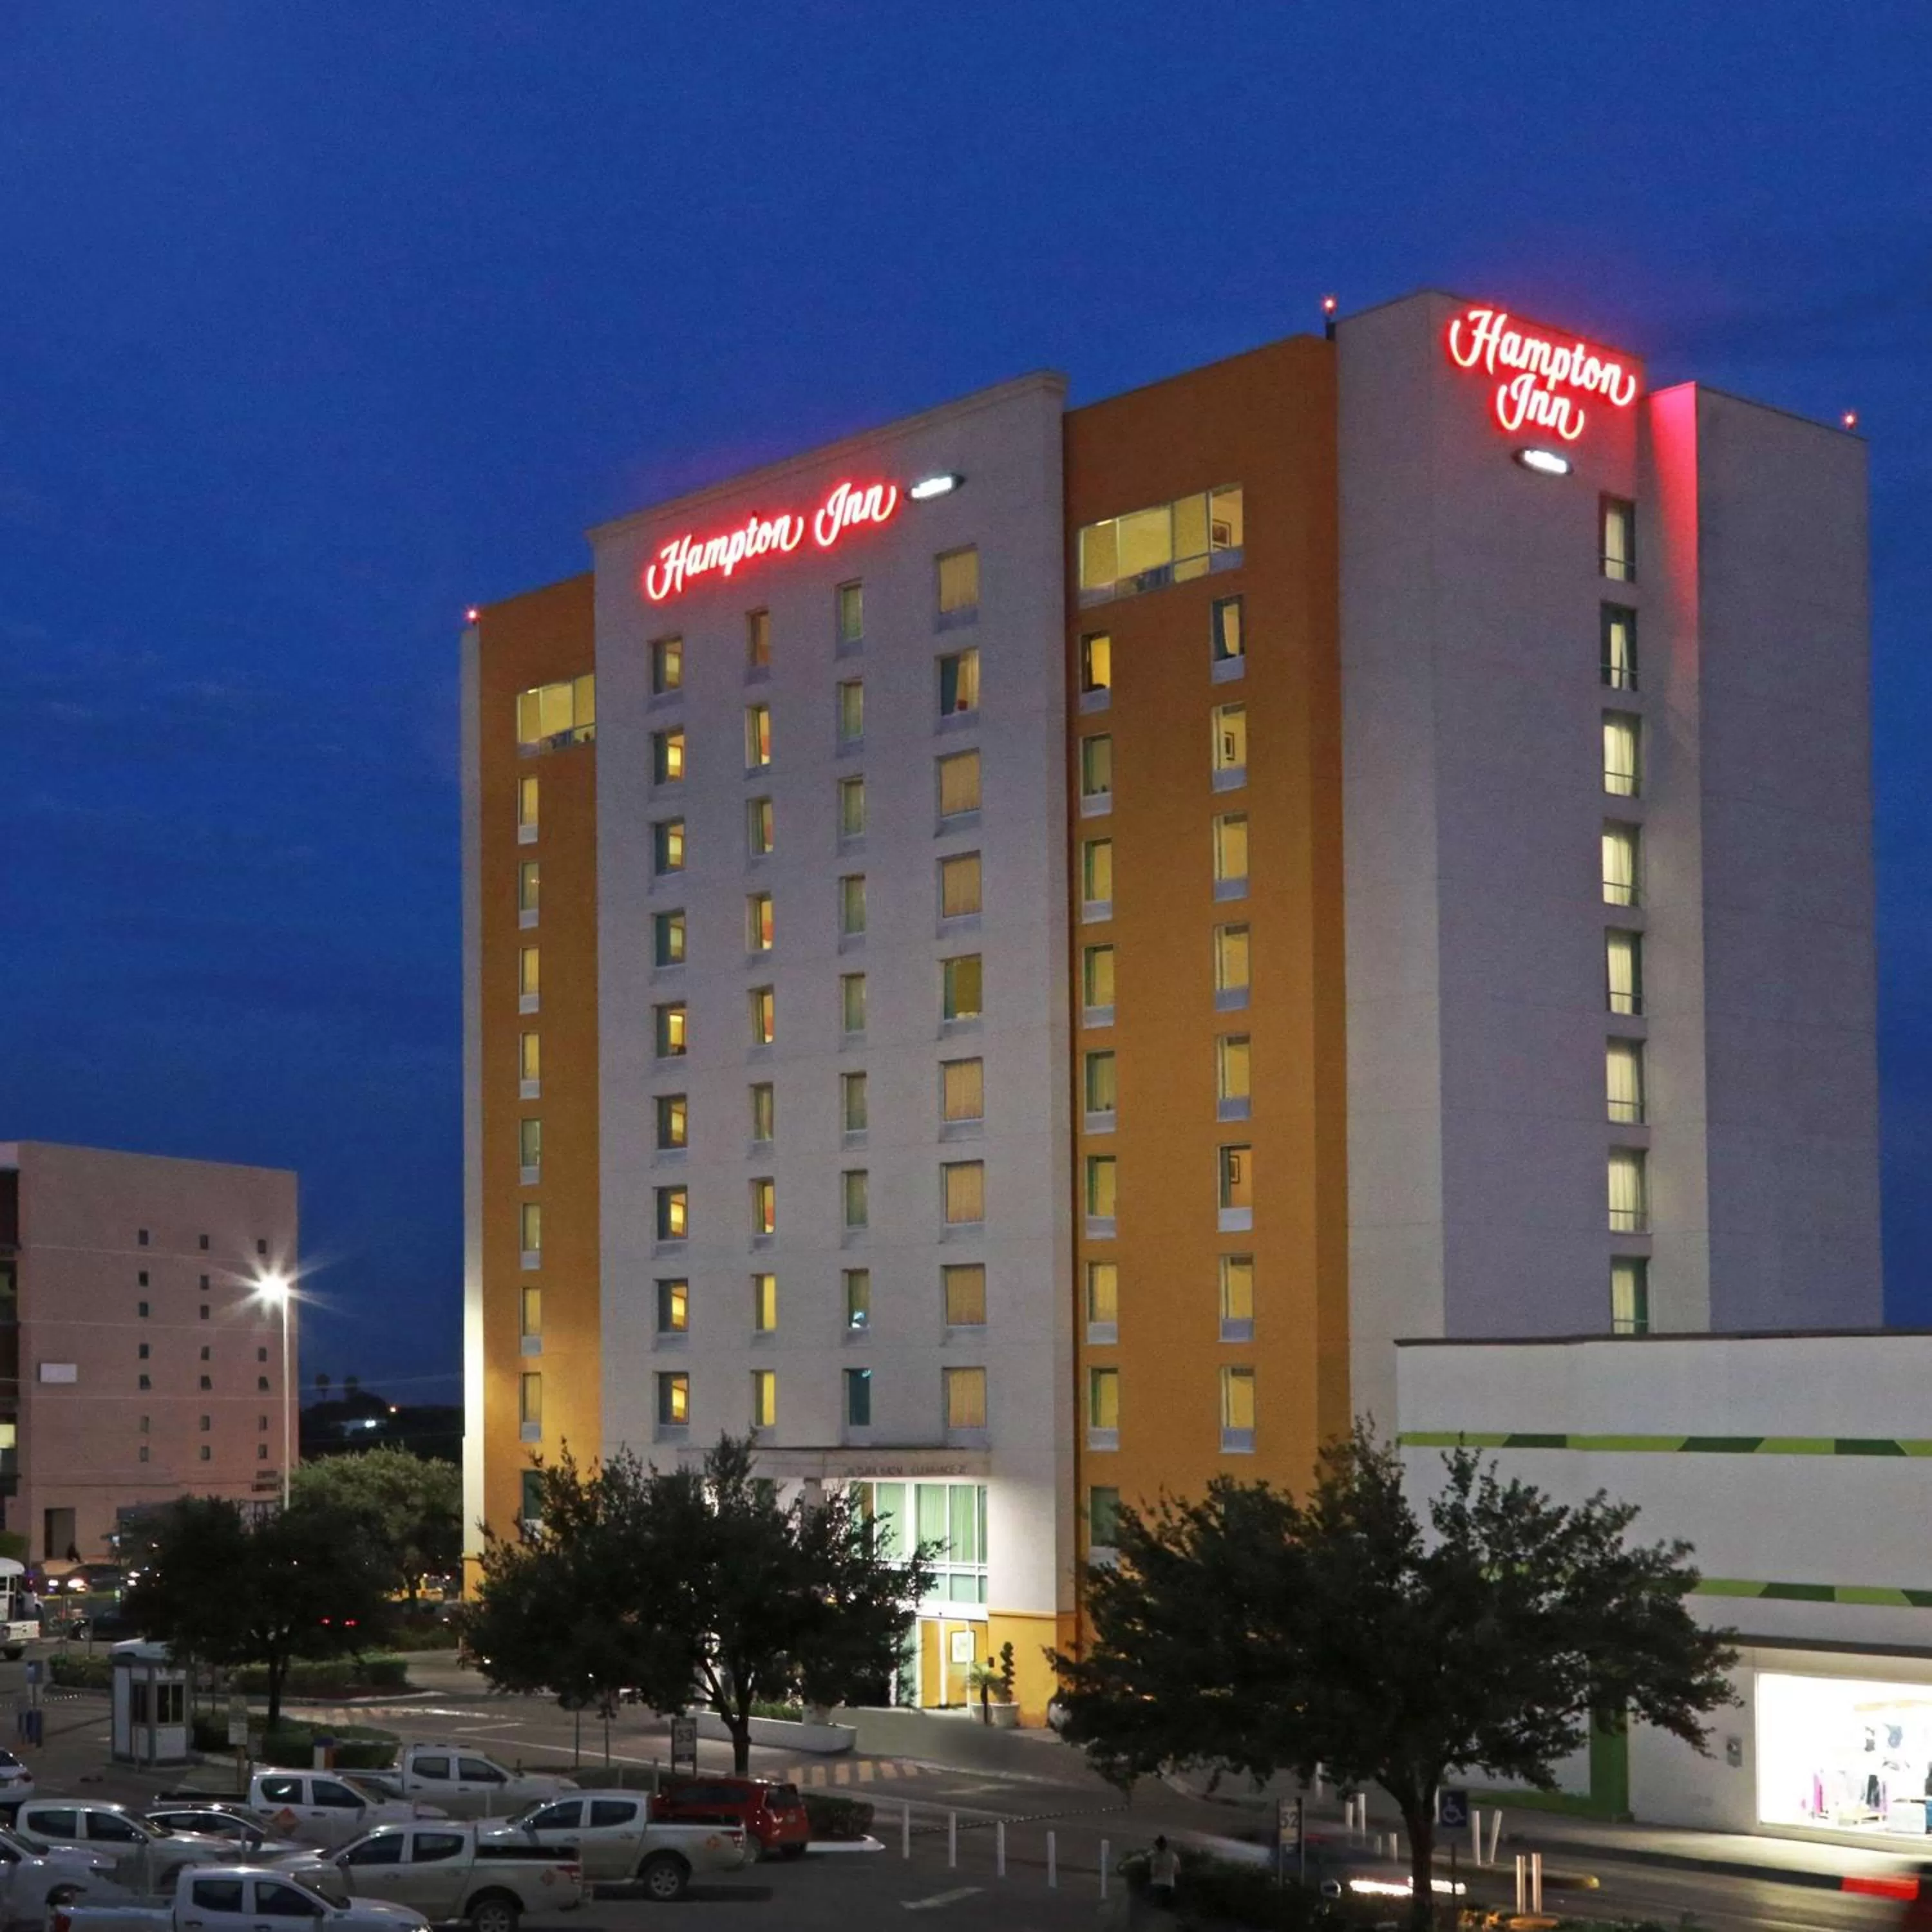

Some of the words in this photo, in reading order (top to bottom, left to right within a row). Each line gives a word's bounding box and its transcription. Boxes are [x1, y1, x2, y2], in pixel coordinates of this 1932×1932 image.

[1450, 310, 1636, 406] Hampton
[1497, 373, 1585, 440] Inn
[647, 515, 804, 600] Hampton
[814, 482, 896, 547] Inn
